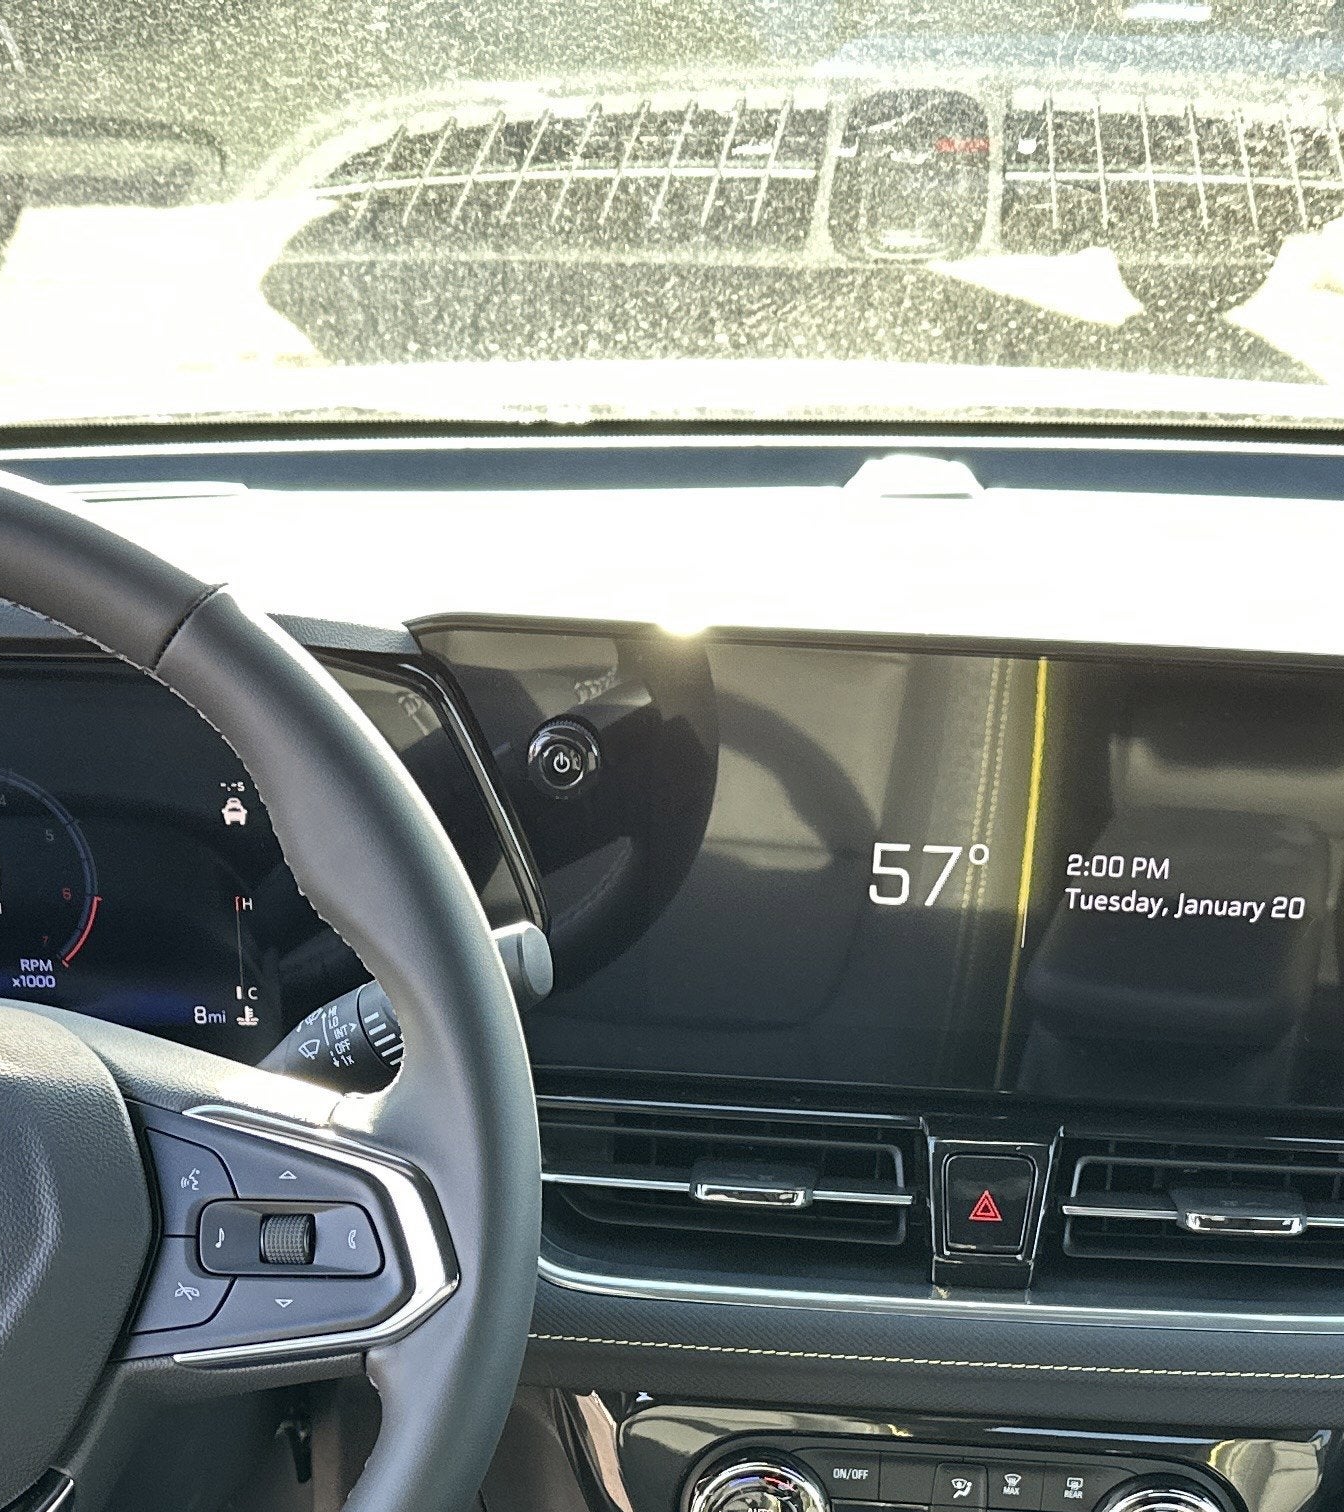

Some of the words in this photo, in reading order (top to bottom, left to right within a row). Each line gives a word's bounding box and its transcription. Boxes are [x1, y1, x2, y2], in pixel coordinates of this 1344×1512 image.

[46, 829, 55, 842] 5
[1066, 854, 1124, 878] 2:00
[1131, 856, 1170, 880] PM
[242, 897, 253, 911] H
[1064, 888, 1169, 917] Tuesday,
[1174, 892, 1265, 923] January
[1271, 897, 1306, 919] 20
[20, 958, 54, 972] RPM
[12, 974, 56, 989] x1000
[247, 986, 258, 1000] C
[328, 1016, 340, 1029] LO
[333, 1025, 349, 1040] INT
[335, 1038, 352, 1055] OFF
[832, 1468, 869, 1480] ON/OFF
[1003, 1486, 1020, 1496] MAX
[1063, 1489, 1083, 1499] REAR
